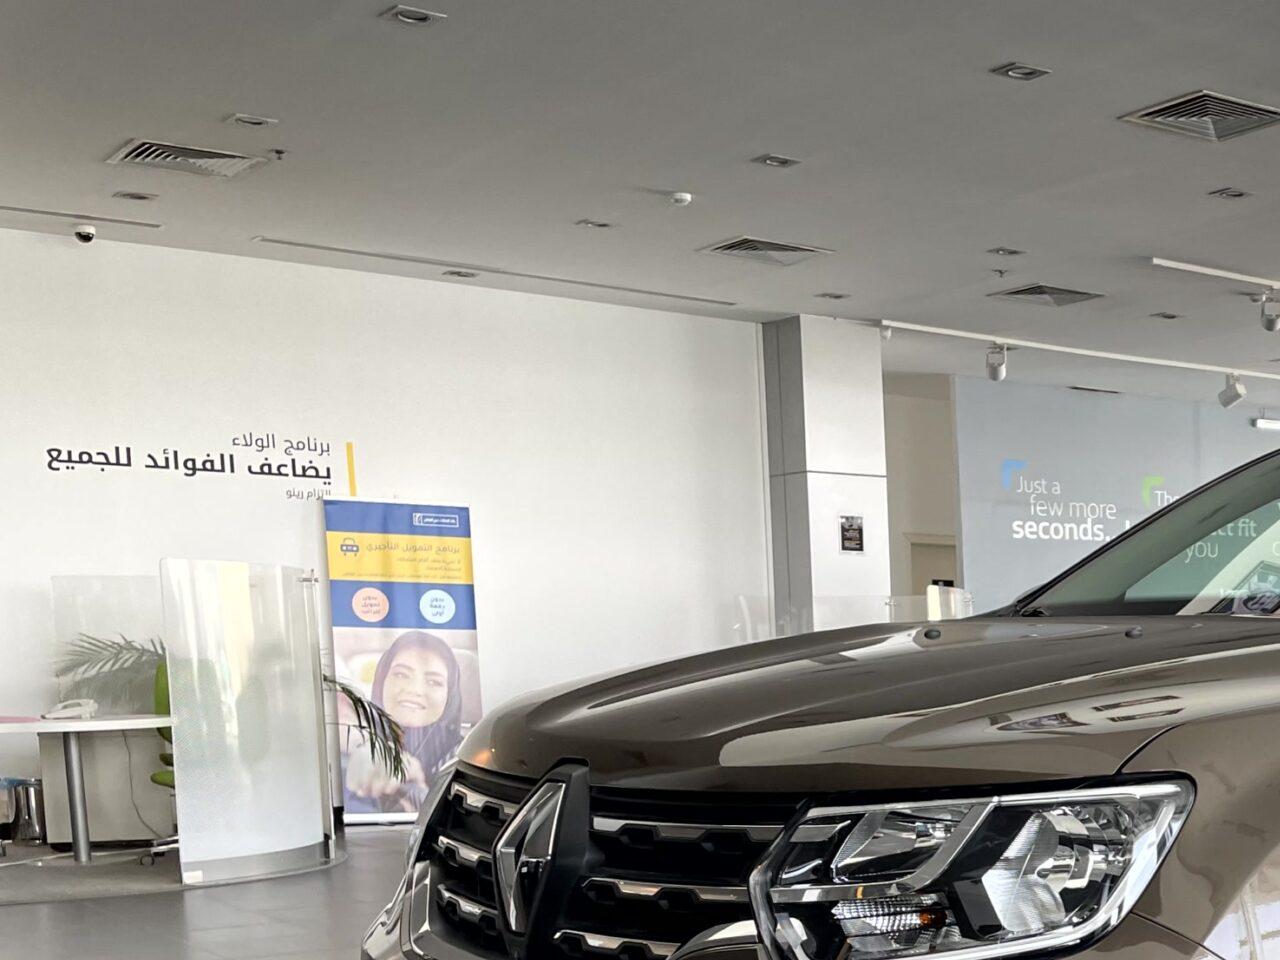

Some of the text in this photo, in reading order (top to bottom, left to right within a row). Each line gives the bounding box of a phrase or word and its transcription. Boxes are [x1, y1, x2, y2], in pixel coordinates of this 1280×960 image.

[232, 432, 331, 457] برنامج الولاء
[46, 446, 331, 485] يضاعف الفوائد للجميع
[1016, 476, 1061, 495] Just a
[1030, 494, 1117, 520] few more
[1238, 518, 1257, 537] fit
[1184, 543, 1219, 564] you
